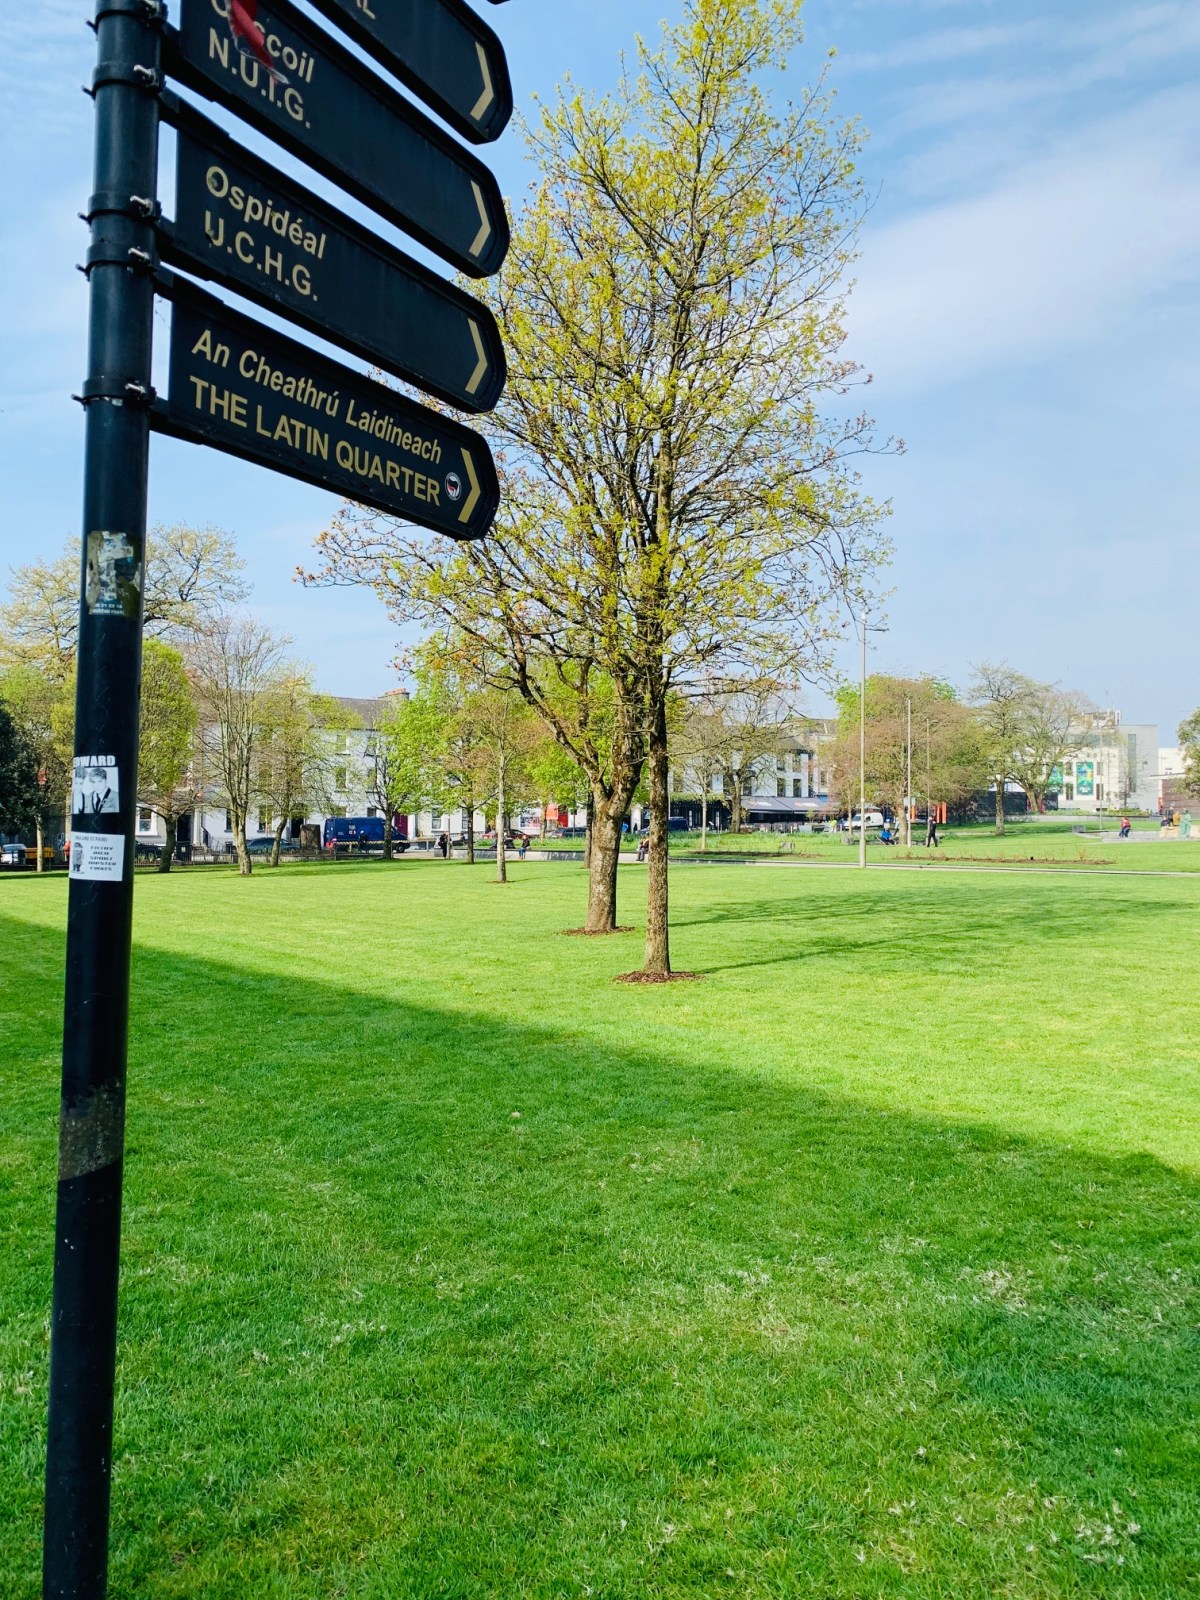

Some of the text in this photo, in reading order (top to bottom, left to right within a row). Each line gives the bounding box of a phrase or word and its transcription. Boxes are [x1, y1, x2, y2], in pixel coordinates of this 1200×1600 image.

[208, 27, 311, 129] N.U.I.G.
[211, 0, 315, 84] coil
[204, 210, 319, 302] U.C.H.G.
[205, 165, 327, 260] Ospidéal
[189, 375, 248, 428] THE
[255, 405, 329, 461] LATIN
[335, 440, 441, 507] QUARTER
[191, 329, 442, 465] An Cheathrú Laidineach
